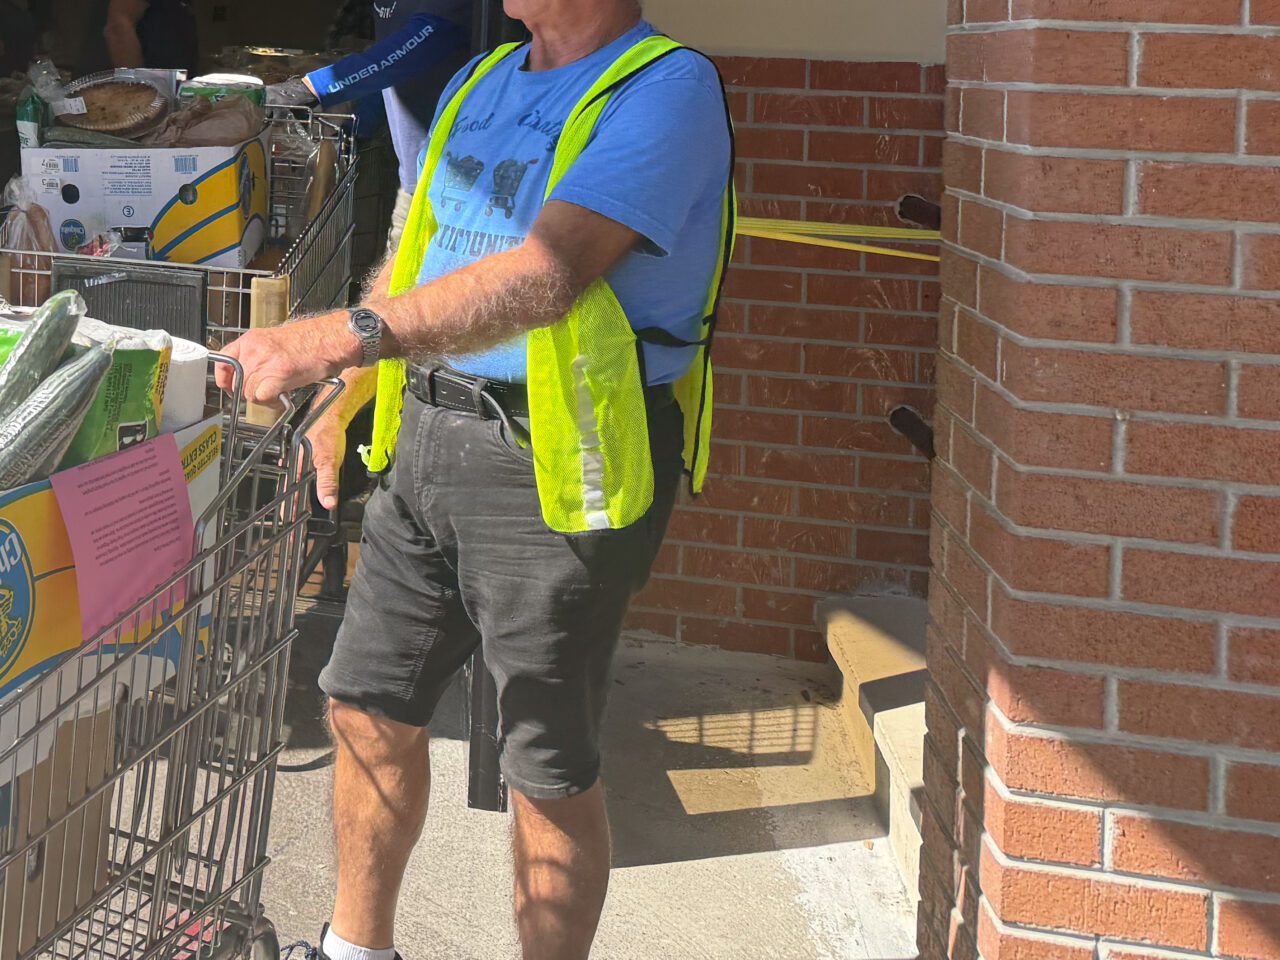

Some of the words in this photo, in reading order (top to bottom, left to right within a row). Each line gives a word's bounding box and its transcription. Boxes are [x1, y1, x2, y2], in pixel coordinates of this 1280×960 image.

[328, 63, 380, 93] UNDER
[381, 25, 434, 70] ARMOUR
[448, 112, 495, 142] Food
[198, 431, 217, 454] CLASS
